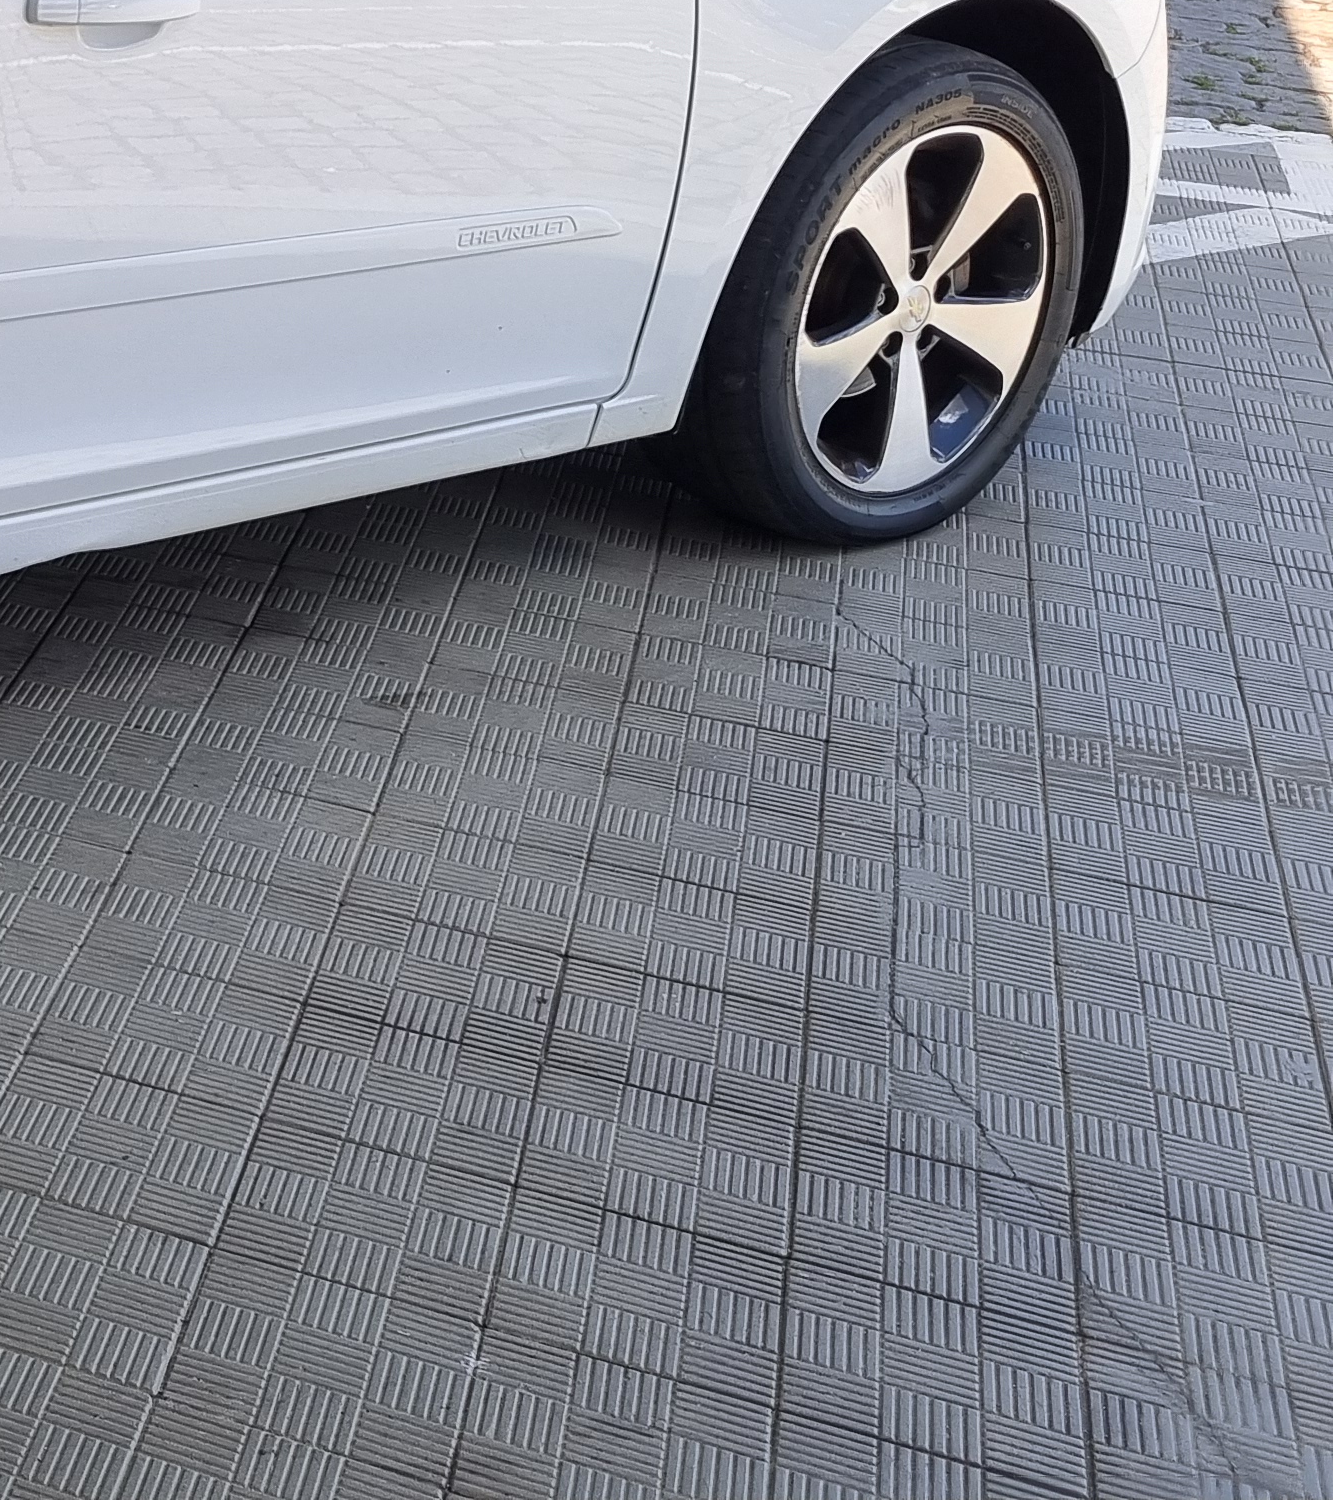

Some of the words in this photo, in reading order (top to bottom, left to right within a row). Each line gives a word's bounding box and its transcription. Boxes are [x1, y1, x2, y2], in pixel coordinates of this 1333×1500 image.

[458, 220, 567, 247] CHEVROLET
[786, 173, 842, 296] SPORT
[847, 118, 901, 176] macro
[914, 88, 963, 115] NA305
